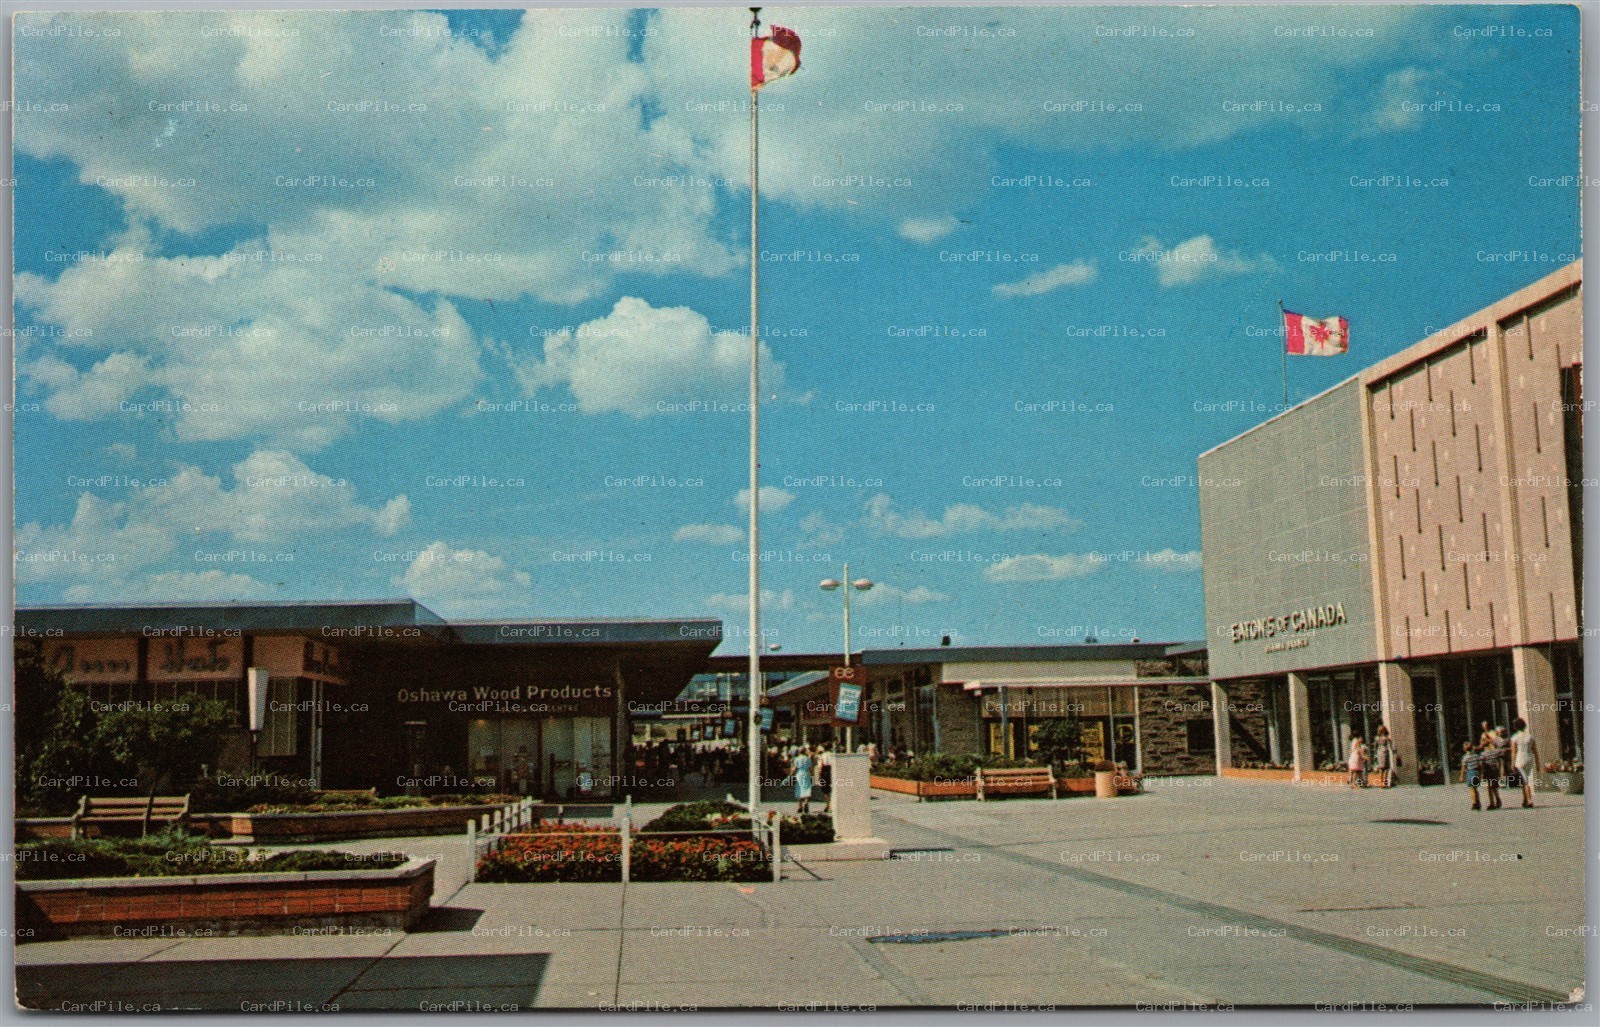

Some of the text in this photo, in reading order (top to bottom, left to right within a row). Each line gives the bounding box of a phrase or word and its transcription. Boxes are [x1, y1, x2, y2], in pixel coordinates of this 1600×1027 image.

[1291, 601, 1348, 633] CANADA
[397, 684, 612, 703] Oshawa Wood Products
